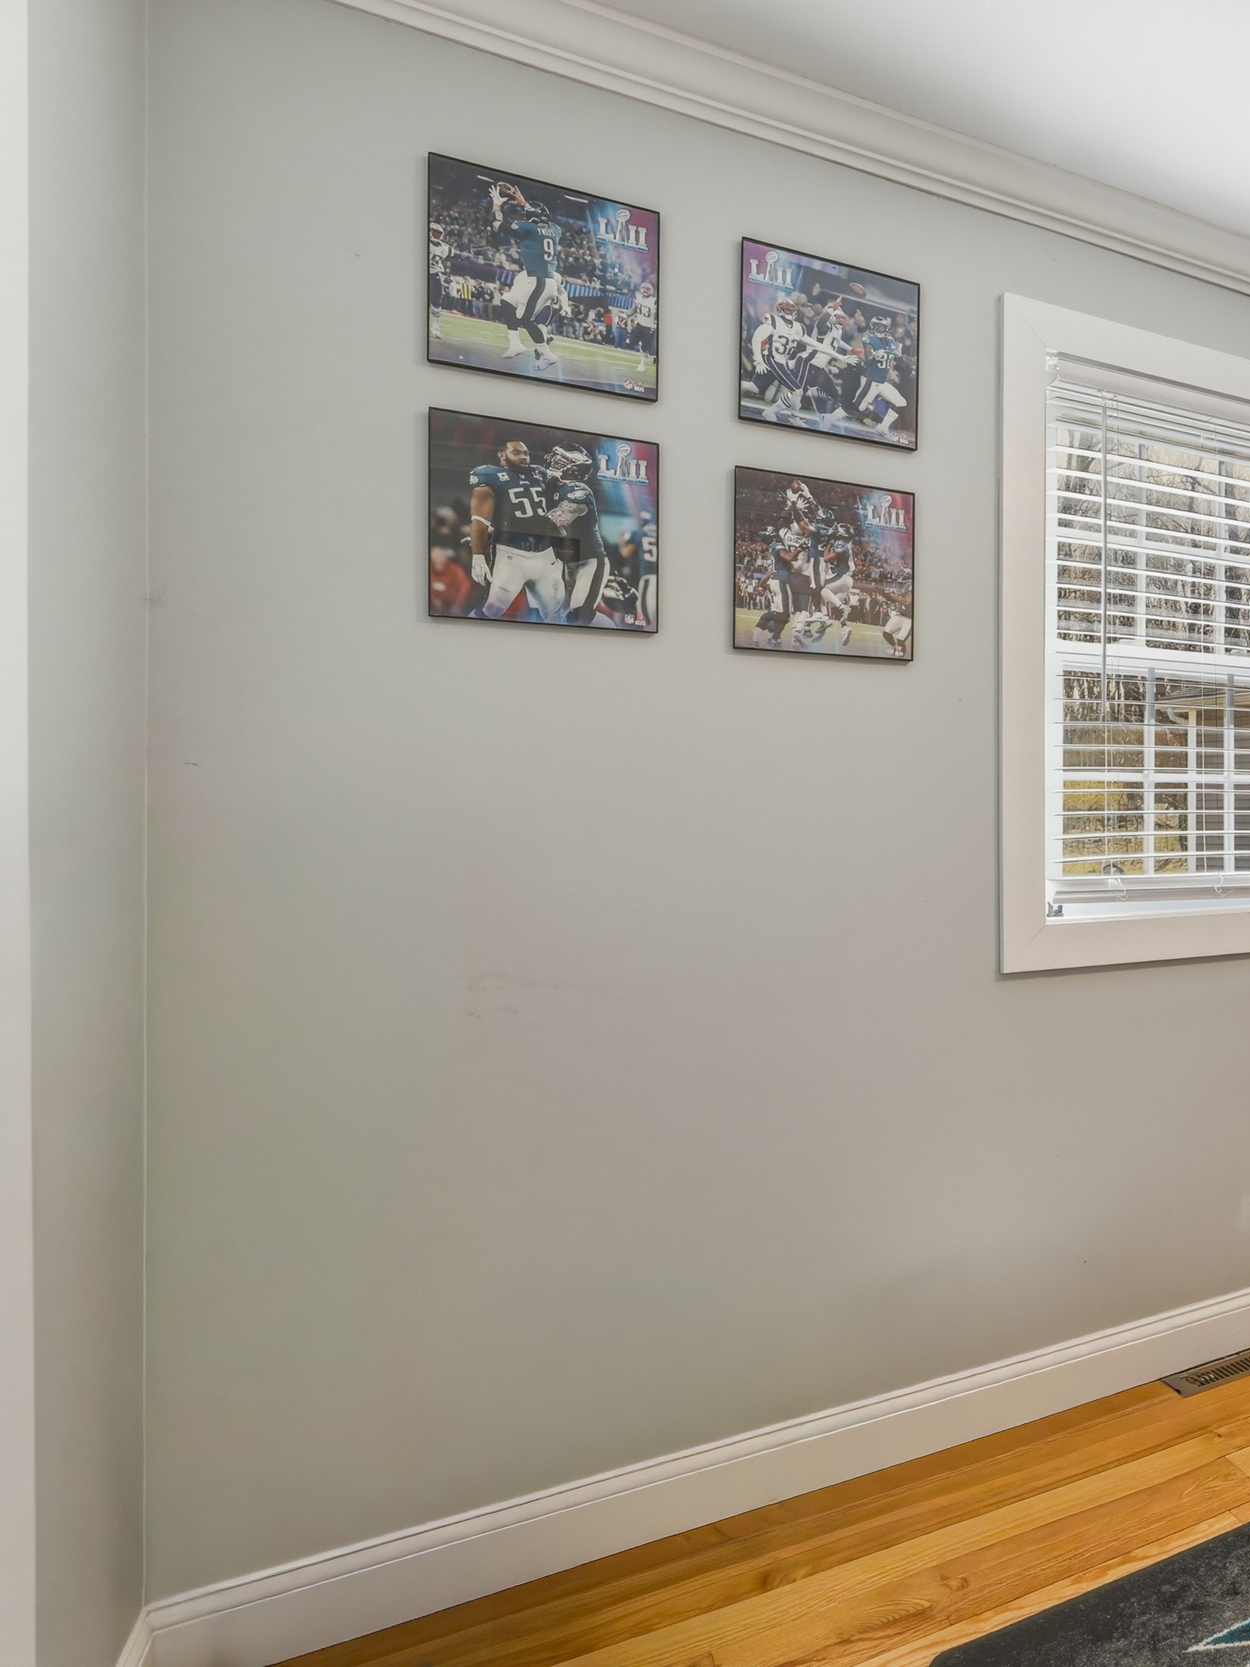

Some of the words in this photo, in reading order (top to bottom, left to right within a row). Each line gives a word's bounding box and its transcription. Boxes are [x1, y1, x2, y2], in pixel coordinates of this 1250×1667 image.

[598, 217, 648, 247] LII
[543, 238, 554, 261] 9
[749, 259, 793, 288] LII
[598, 454, 648, 481] LII
[508, 487, 547, 518] 55
[866, 504, 906, 526] LII
